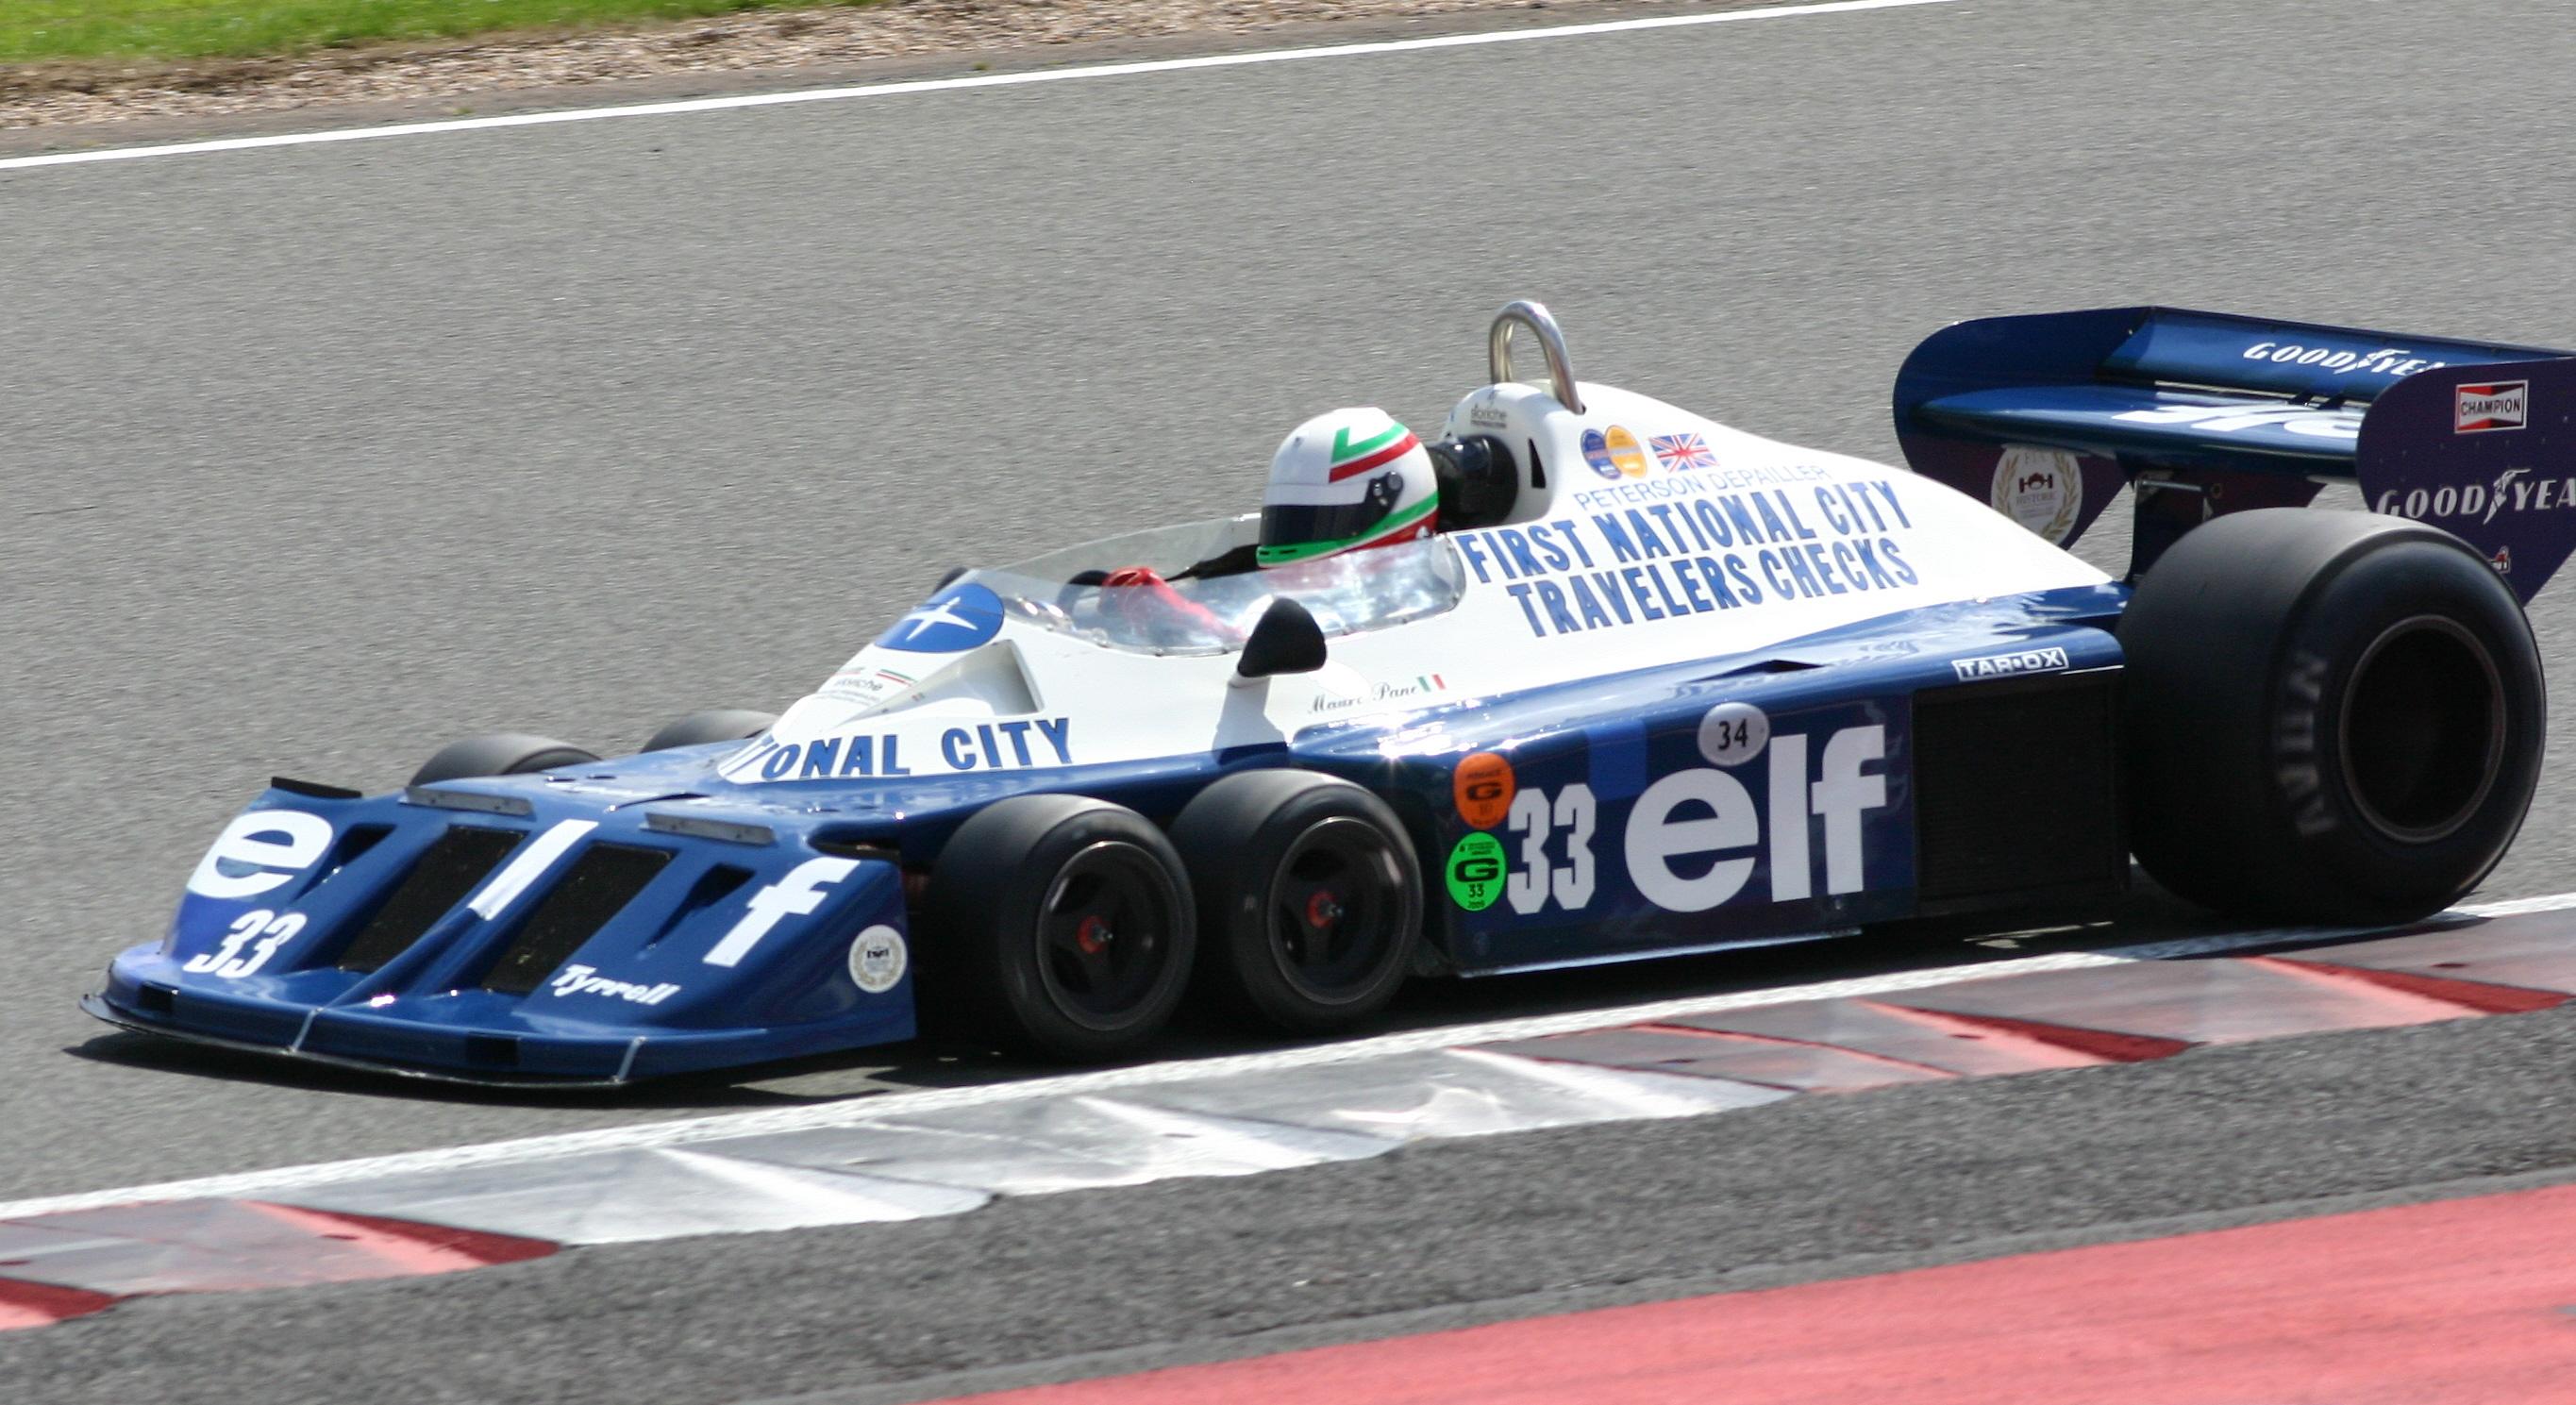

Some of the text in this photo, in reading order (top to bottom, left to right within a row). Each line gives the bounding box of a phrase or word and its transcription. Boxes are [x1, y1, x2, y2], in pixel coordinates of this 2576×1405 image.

[2460, 398, 2521, 416] CHAMPION
[1573, 464, 1832, 510] PETERSON DEPAILLER
[1455, 480, 1912, 583] FIRST NATIONAL CITY
[1506, 538, 1918, 637] TRAVELERS CHECKS
[941, 717, 1072, 772] CITY
[1717, 718, 1748, 750] 34
[1625, 725, 1887, 912] elf
[1455, 858, 1499, 882] G
[1507, 783, 1596, 914] 33
[1467, 883, 1485, 897] 33
[184, 910, 308, 978] 33
[551, 963, 682, 1005] Tyrrell
